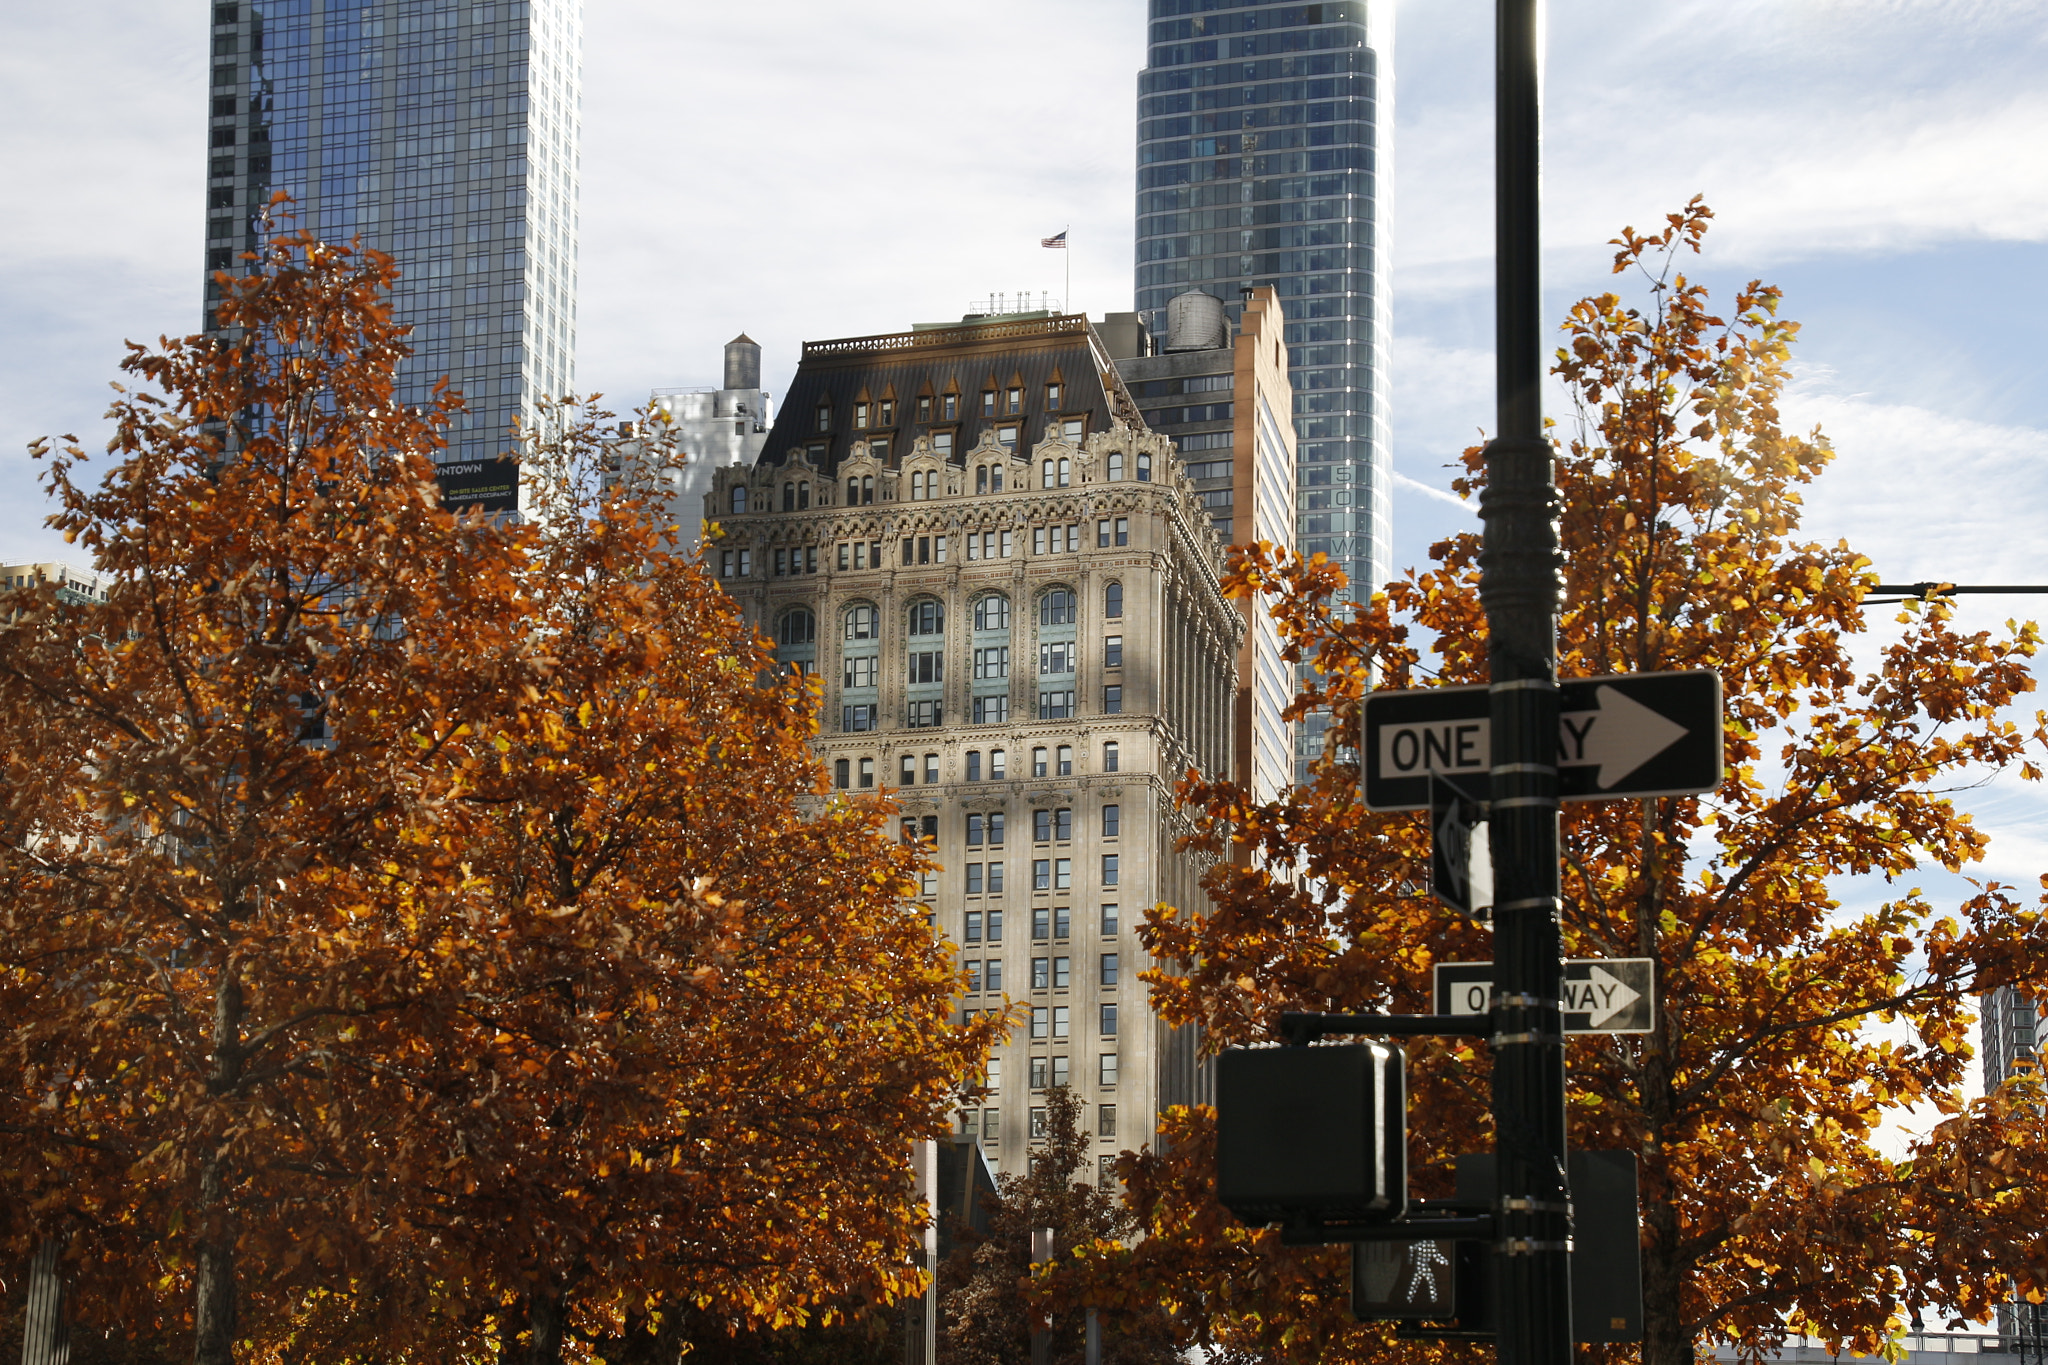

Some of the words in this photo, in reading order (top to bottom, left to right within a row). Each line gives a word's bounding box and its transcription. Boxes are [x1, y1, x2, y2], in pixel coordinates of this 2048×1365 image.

[431, 464, 482, 476] WNTOWN
[488, 484, 510, 492] CENTER
[449, 493, 478, 501] IMMEDIATE
[1391, 724, 1481, 771] ONE
